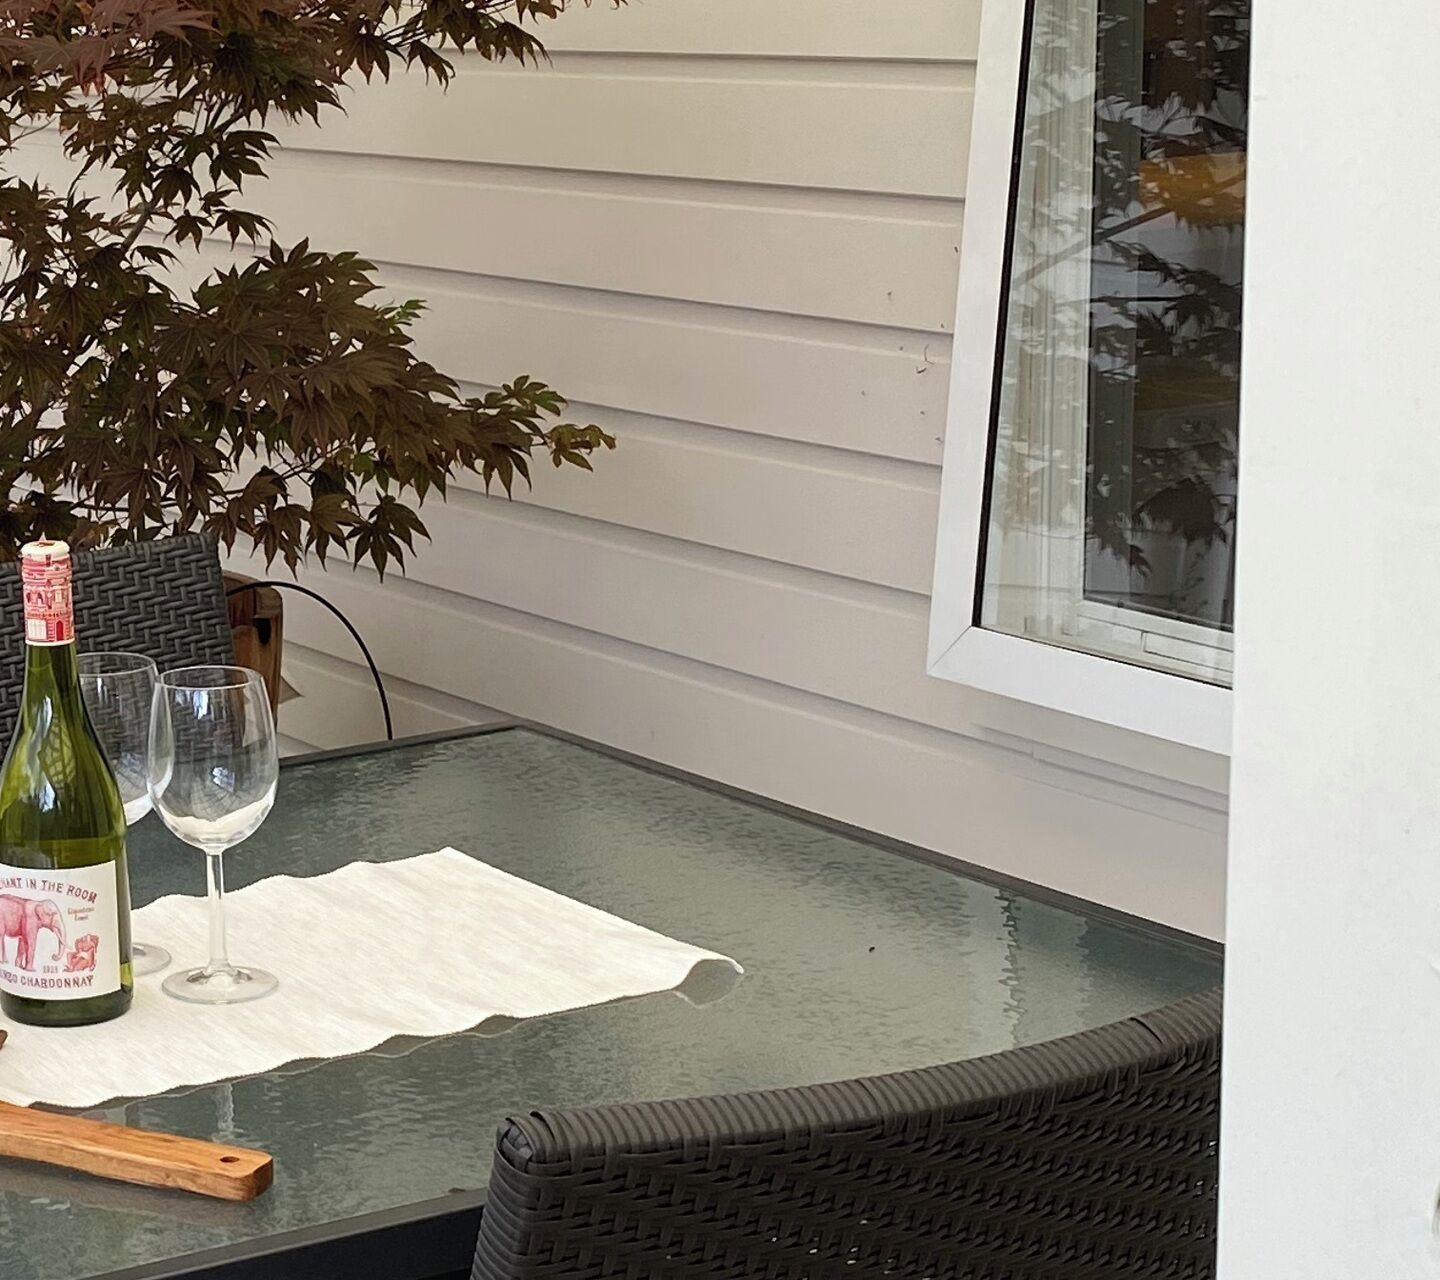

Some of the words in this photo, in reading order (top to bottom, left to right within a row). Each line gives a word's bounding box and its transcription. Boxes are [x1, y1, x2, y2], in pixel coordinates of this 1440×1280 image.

[26, 878, 37, 889] IN
[40, 879, 64, 893] THE
[66, 885, 98, 904] ROOM
[20, 974, 94, 989] CHARDONNAY
